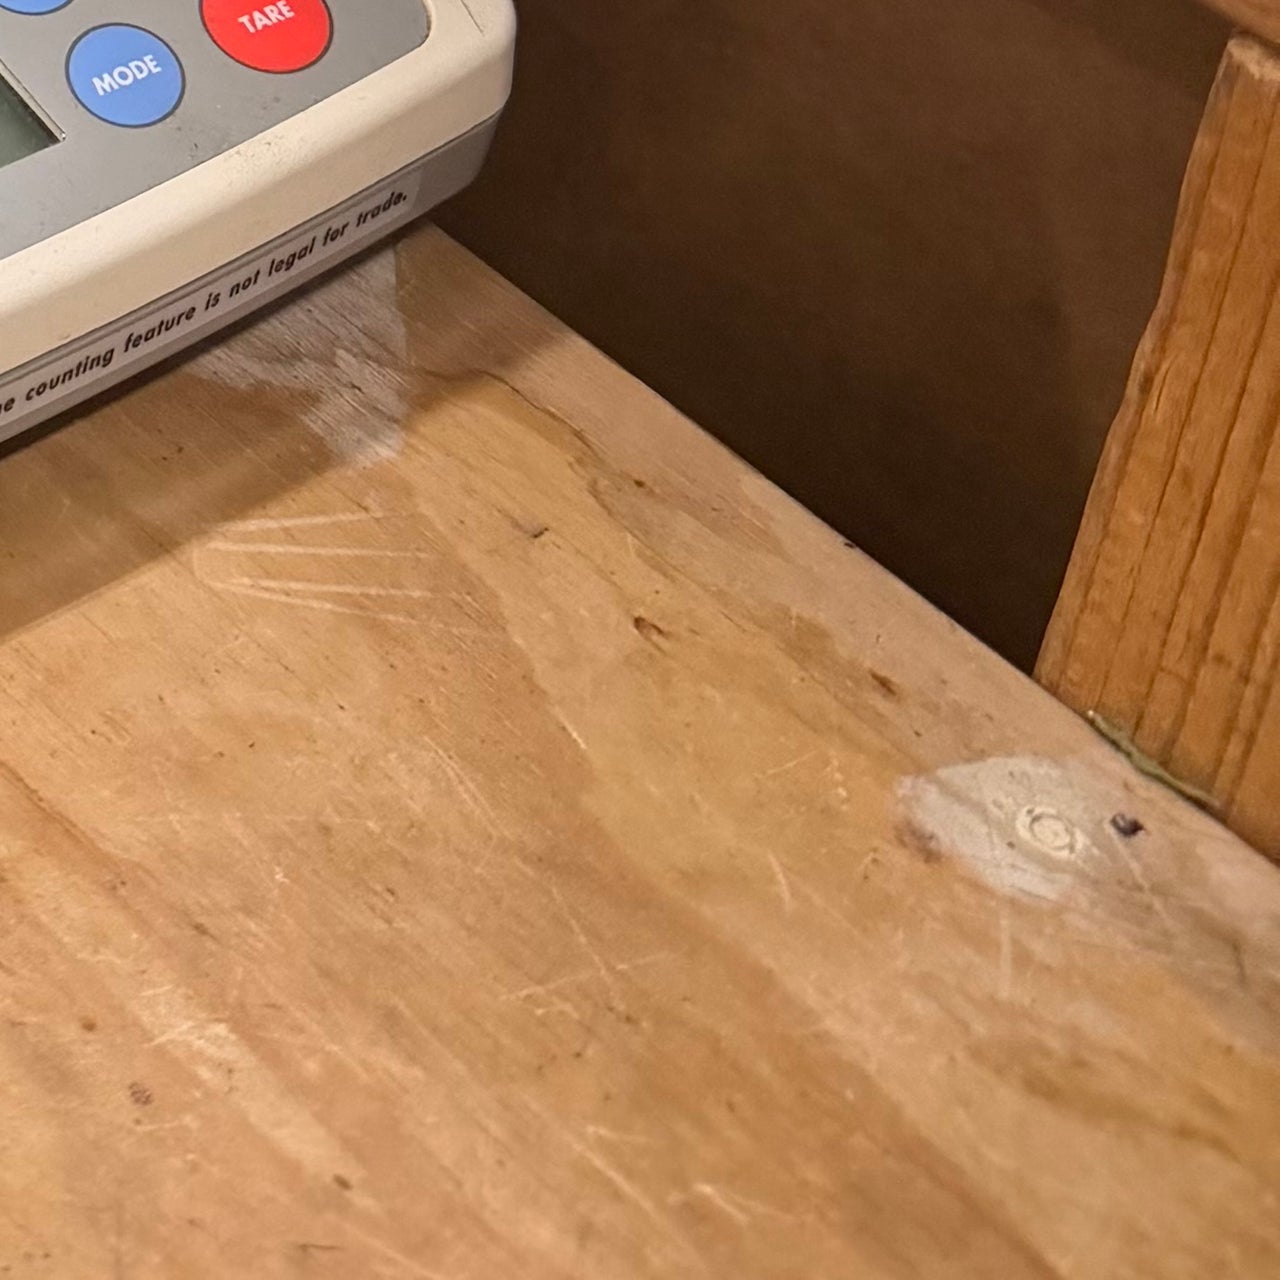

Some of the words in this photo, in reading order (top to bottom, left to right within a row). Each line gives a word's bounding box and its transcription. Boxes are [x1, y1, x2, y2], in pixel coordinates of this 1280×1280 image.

[238, 0, 295, 34] TARE
[91, 54, 163, 97] MODE
[25, 347, 115, 402] counting
[123, 306, 196, 353] feature
[204, 292, 221, 310] is
[228, 269, 261, 298] not
[268, 236, 316, 277] legal
[322, 222, 349, 246] for
[355, 190, 407, 227] trade.
